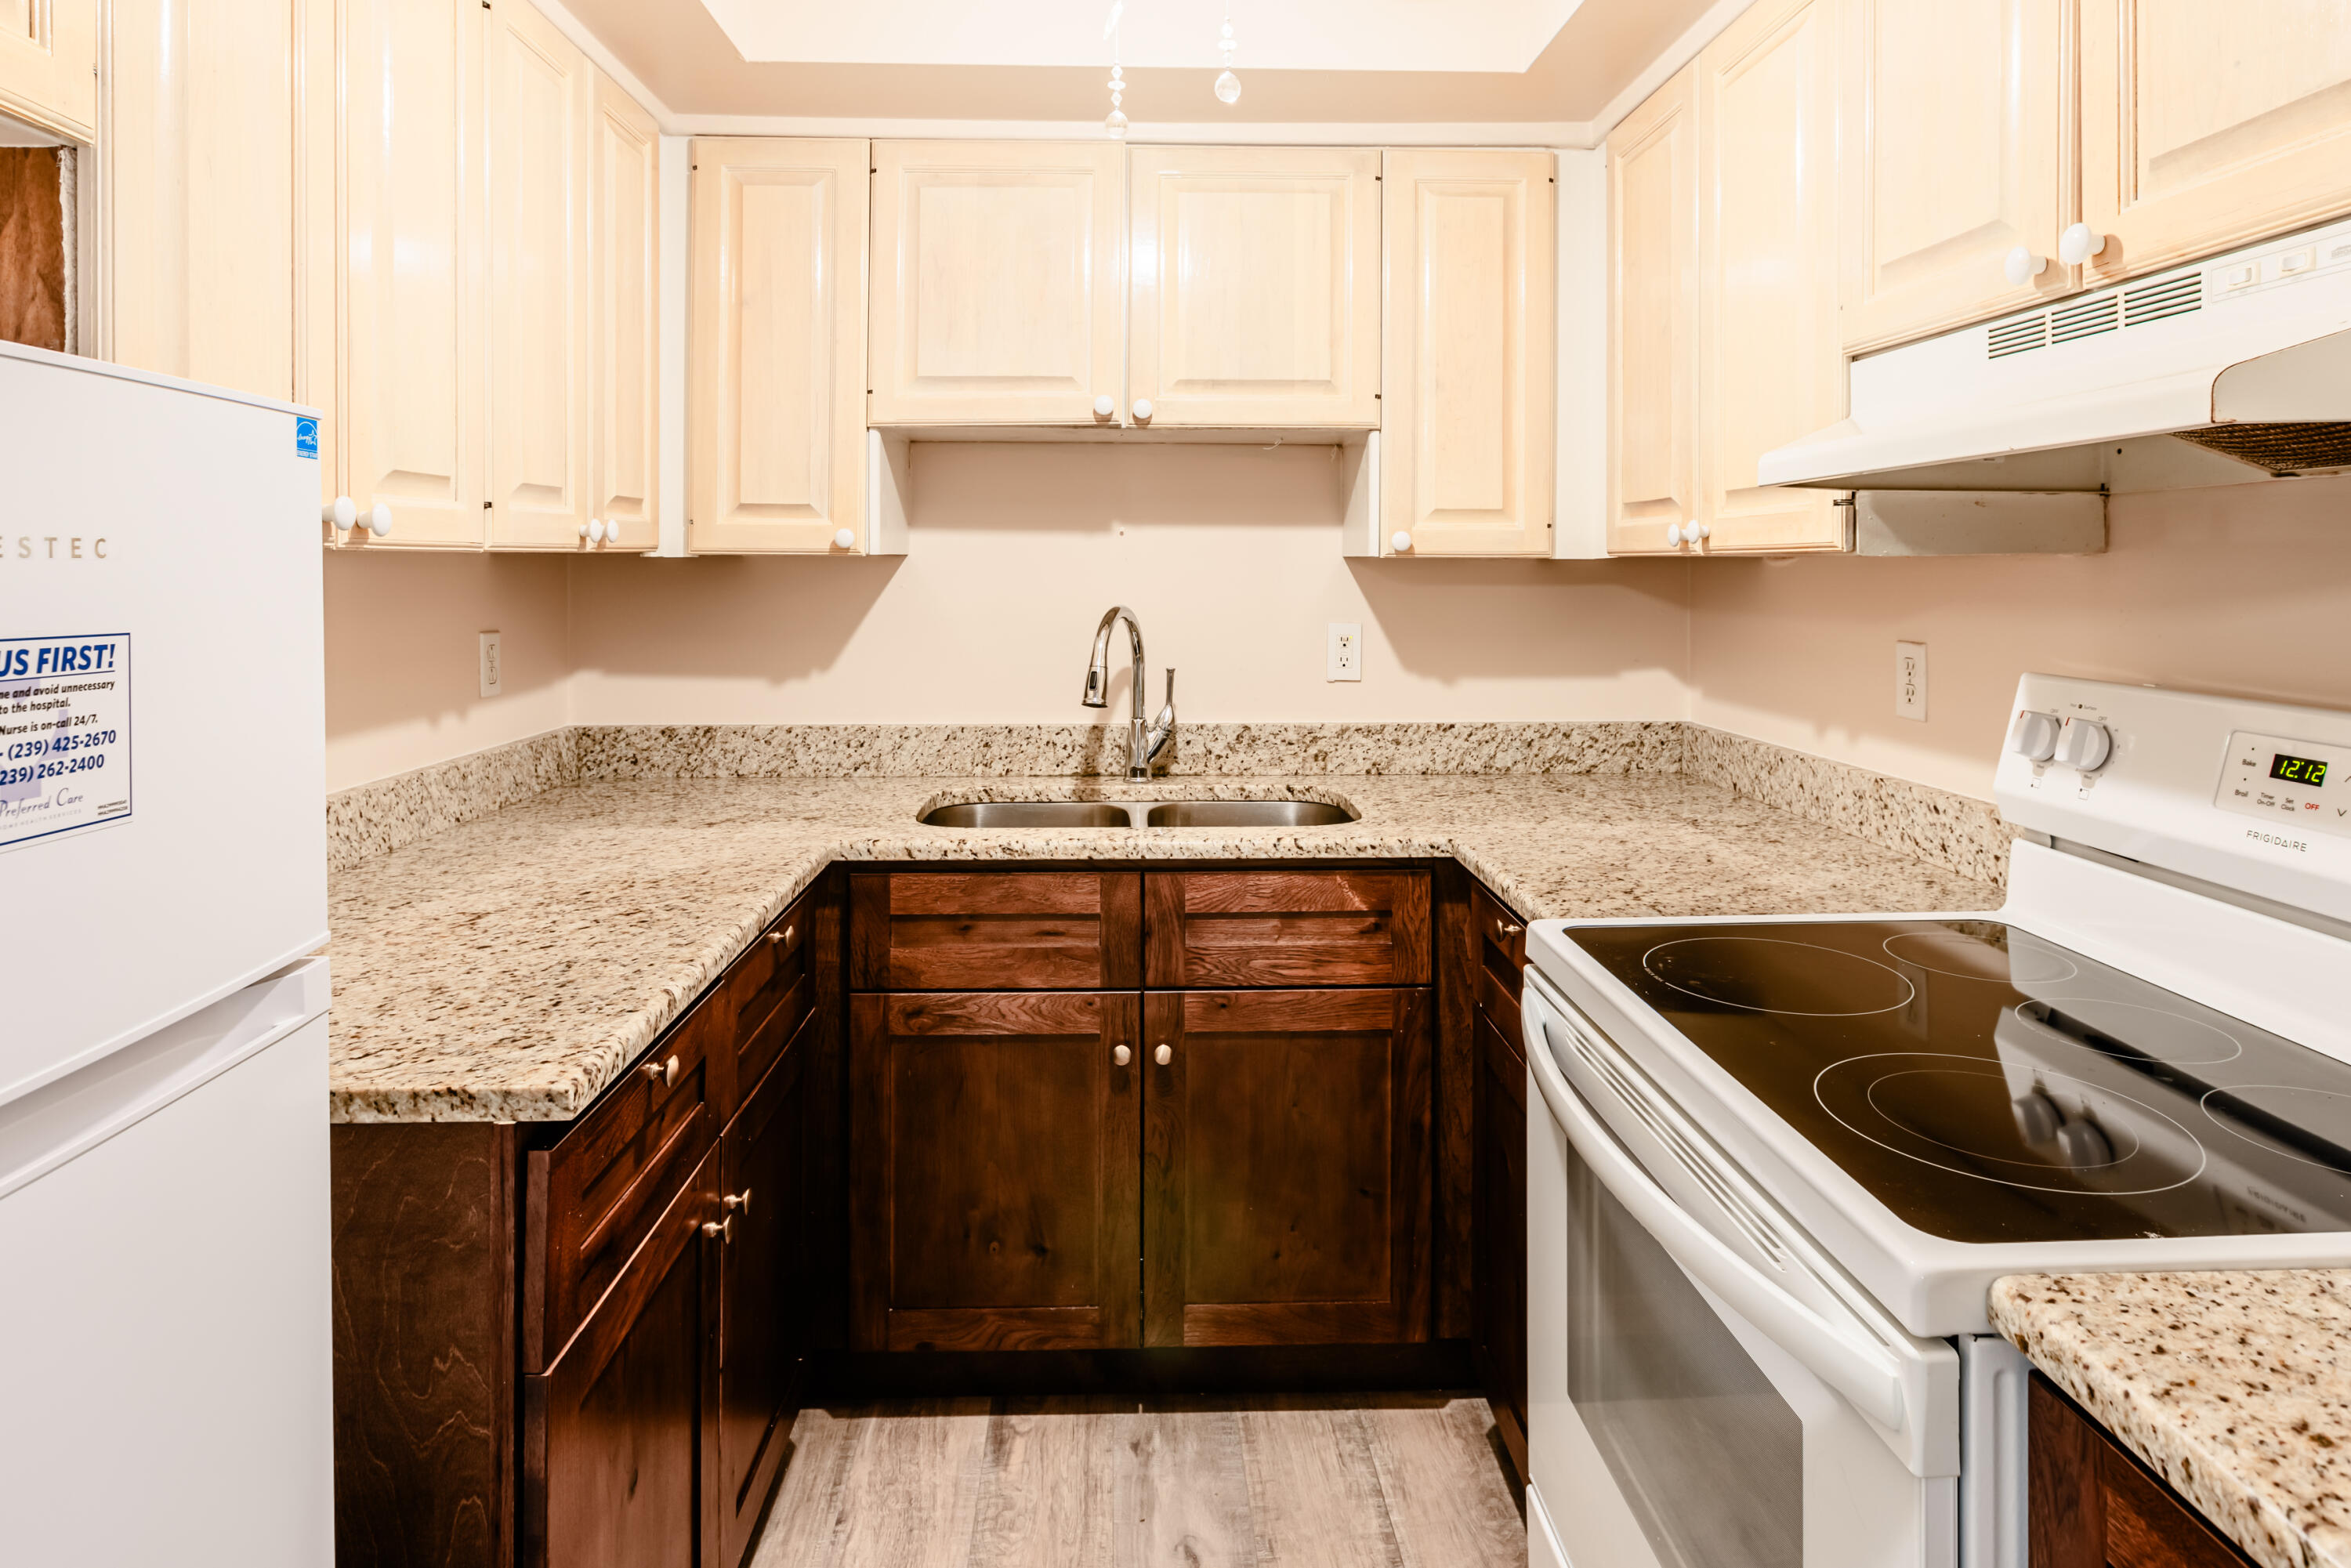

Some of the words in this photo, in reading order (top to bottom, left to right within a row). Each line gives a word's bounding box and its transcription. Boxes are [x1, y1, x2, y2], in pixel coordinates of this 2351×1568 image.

[0, 536, 107, 559] STEC
[0, 649, 30, 677] US
[36, 643, 116, 674] FIRST!
[13, 686, 31, 698] and
[33, 683, 60, 696] avoid
[61, 680, 115, 693] unnecessary
[12, 701, 27, 713] the
[30, 697, 71, 712] hospital.
[31, 721, 38, 732] is
[41, 716, 72, 730] on-call
[74, 714, 98, 726] 24/7.
[8, 738, 49, 761] (239)
[52, 730, 117, 752] 425-2670
[37, 754, 105, 780] 262-2400
[2279, 759, 2326, 783] 12:12
[0, 795, 52, 818] Preferred
[56, 787, 84, 806] Care
[2304, 802, 2320, 811] OFF
[2246, 829, 2308, 853] FRIGIDAIRE
